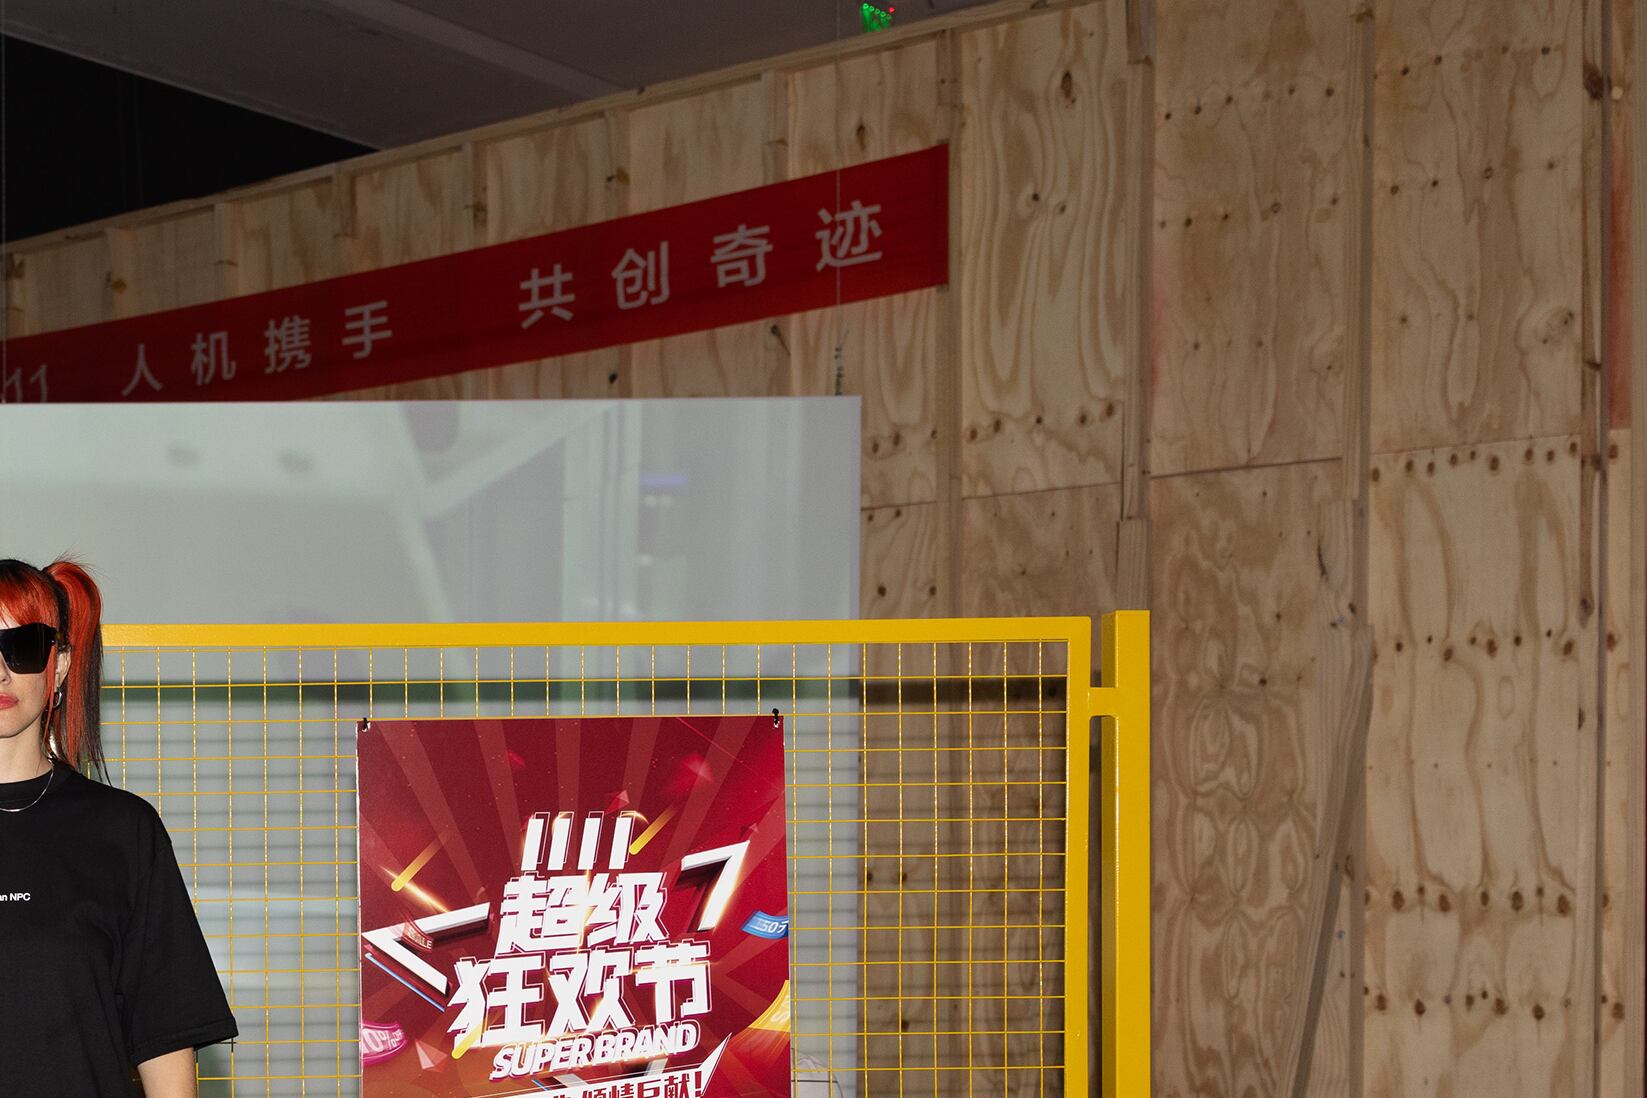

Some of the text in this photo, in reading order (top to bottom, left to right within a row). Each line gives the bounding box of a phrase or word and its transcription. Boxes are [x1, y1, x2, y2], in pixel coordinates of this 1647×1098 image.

[121, 300, 393, 397] 人机携手
[518, 200, 883, 329] 共创奇迹
[9, 893, 30, 901] NPC
[495, 871, 669, 957] 超级
[447, 940, 712, 1048] 狂欢节
